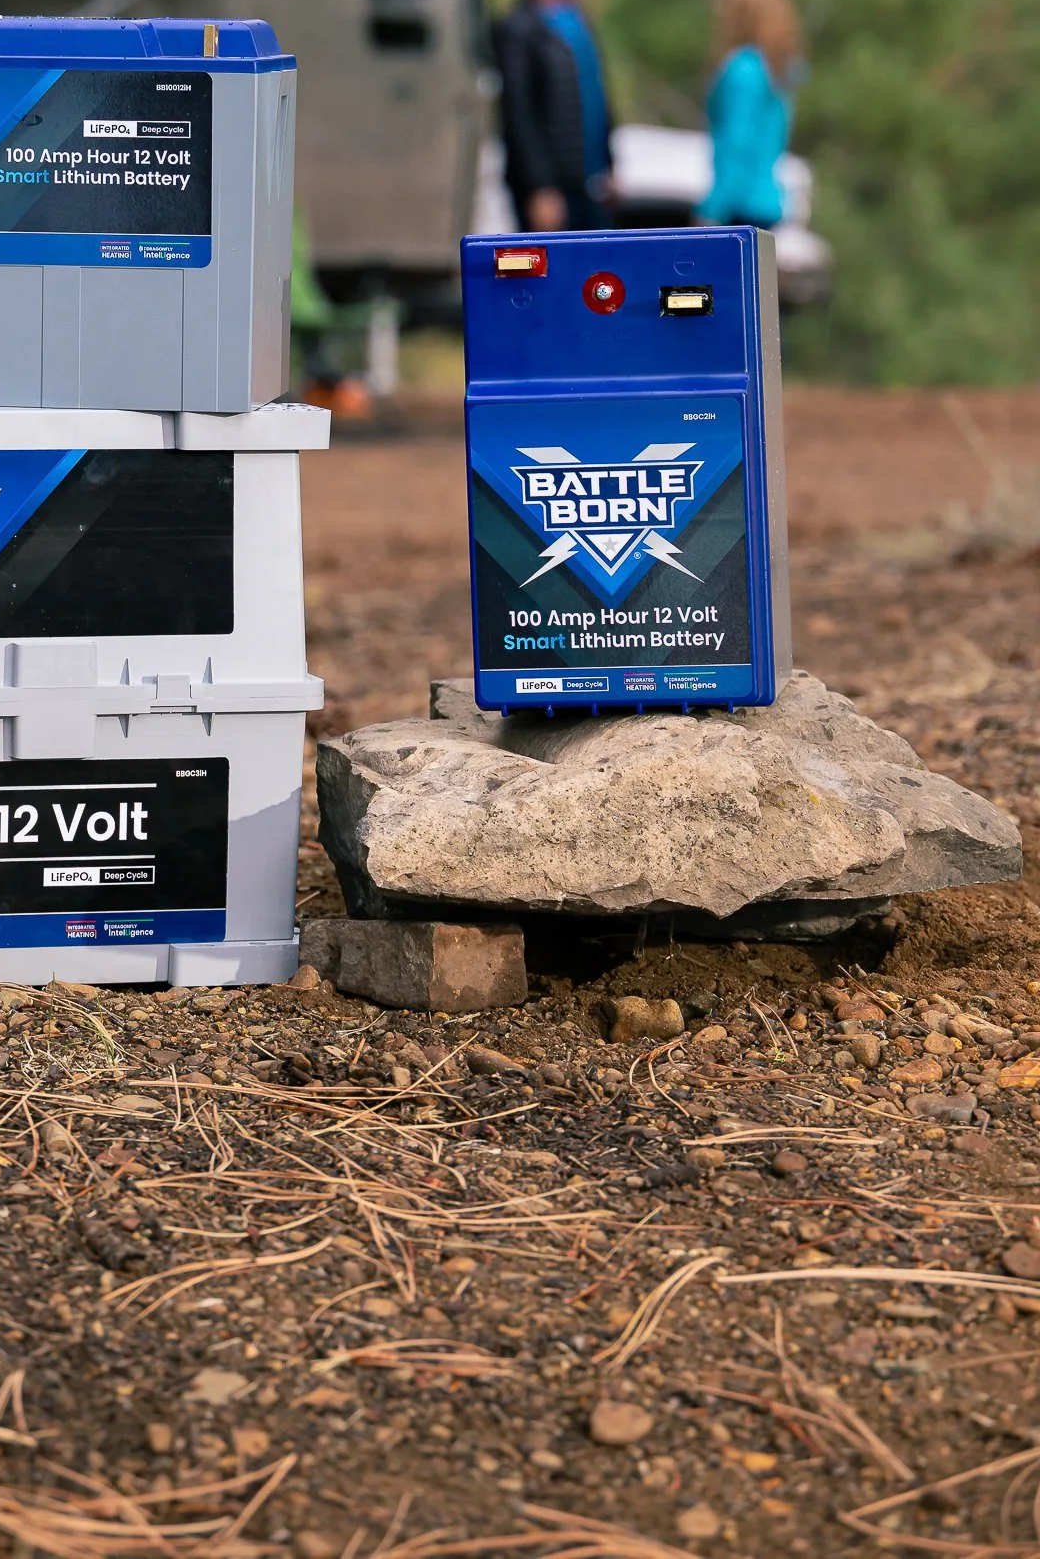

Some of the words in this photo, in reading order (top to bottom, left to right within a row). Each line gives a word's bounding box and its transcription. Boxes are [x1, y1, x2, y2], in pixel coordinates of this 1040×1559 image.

[141, 125, 162, 134] Deep
[162, 125, 184, 134] Cycle
[5, 148, 35, 163] 100
[39, 148, 83, 168] Amp
[87, 149, 130, 164] Hour
[134, 149, 151, 164] 12
[155, 150, 191, 165] Volt
[53, 169, 121, 185] Lithium
[124, 170, 191, 190] Battery
[526, 468, 686, 497] BATTLE
[547, 497, 668, 524] BORN
[509, 610, 542, 627] 100
[547, 609, 596, 630] Amp
[601, 608, 648, 625] Hour
[653, 607, 673, 624] 12
[676, 606, 718, 623] Volt
[503, 634, 566, 650] Smart
[570, 631, 646, 649] Lithium
[650, 631, 725, 650] Battery
[566, 681, 584, 689] Deep
[584, 680, 603, 689] Cycle
[51, 802, 148, 841] Volt
[104, 871, 125, 881] Deep
[126, 870, 148, 880] Cycle
[67, 931, 95, 939] HEATING
